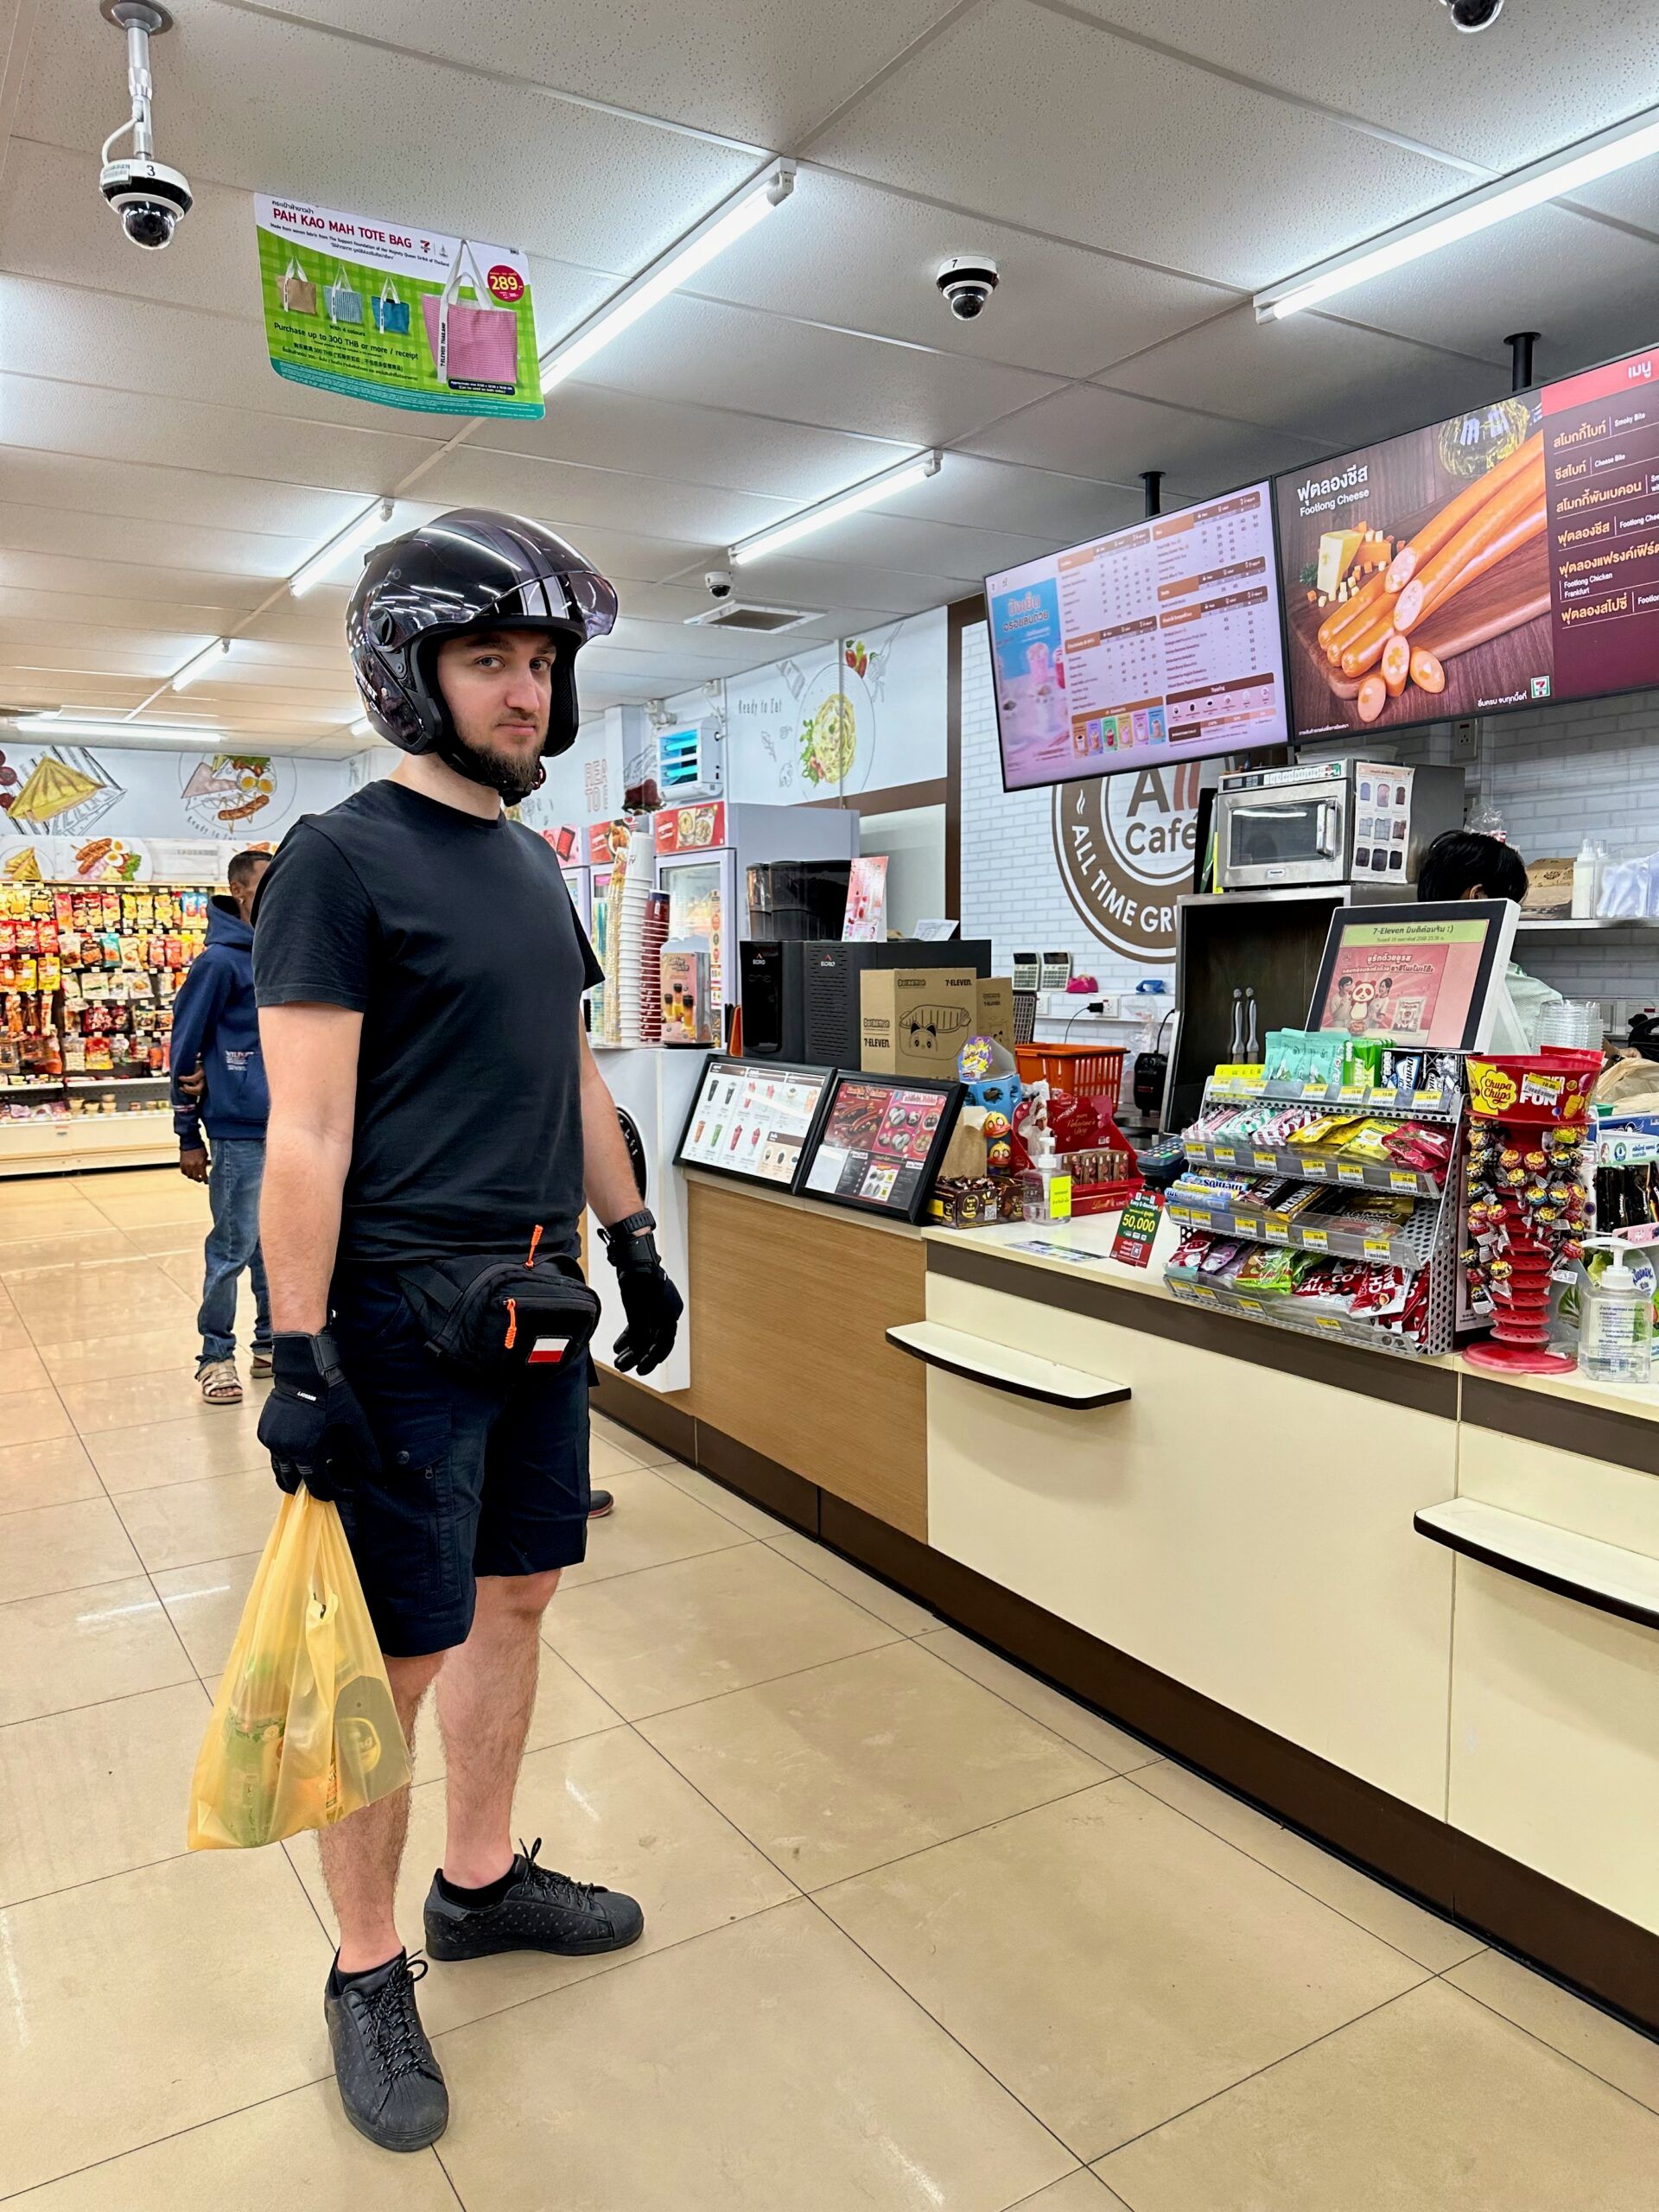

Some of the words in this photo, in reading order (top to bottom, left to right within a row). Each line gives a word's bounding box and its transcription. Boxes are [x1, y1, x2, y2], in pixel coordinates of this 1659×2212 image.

[146, 164, 156, 176] 3
[273, 207, 297, 224] PAH
[301, 214, 325, 229] KAO
[329, 220, 354, 235] MAH
[359, 226, 385, 243] TOTE
[390, 234, 412, 249] BAG
[338, 237, 353, 245] Support
[353, 241, 375, 250] Foundation
[389, 248, 404, 257] Majesty
[434, 259, 449, 268] Thailand
[952, 258, 958, 268] 7
[274, 322, 306, 337] Purchase
[308, 332, 317, 340] up
[319, 333, 327, 341] to
[328, 334, 343, 345] 300
[345, 338, 359, 348] THB
[370, 345, 388, 353] more
[395, 349, 419, 360] receipt
[347, 328, 365, 337] colours
[1628, 360, 1652, 378] เมนู
[1614, 416, 1633, 428] Smoky
[1634, 411, 1645, 422] Bite
[1554, 420, 1606, 448] สโมกกี้ไบท์
[1554, 459, 1586, 480] ชีสไบท์
[1594, 456, 1614, 467] Cheese
[1615, 454, 1625, 462] Bite
[1297, 464, 1369, 506] ฟุตลองชีส
[1300, 499, 1336, 517] Footlong
[1337, 489, 1370, 505] Cheese
[1556, 480, 1643, 513] สโมกกี้พันเบคอน
[1619, 517, 1644, 529] Footlong
[1557, 521, 1610, 548] ฟุตลองชีส
[1564, 577, 1588, 589] Footlong
[1589, 572, 1613, 584] Chicken
[1564, 587, 1590, 599] Frankfurt
[1561, 593, 1628, 625] ฟุตลองสไปซี่
[739, 699, 757, 716] Ready
[760, 700, 767, 714] to
[771, 698, 782, 714] Eat
[1127, 763, 1201, 817] All
[1126, 812, 1198, 855] Café
[1071, 825, 1096, 875] ALL
[1090, 869, 1138, 926] TIME
[1140, 905, 1176, 932] GR
[1372, 926, 1404, 935] 7-Eleven
[1484, 1078, 1512, 1090] Chupa
[1484, 1088, 1511, 1103] Chups
[1519, 1091, 1557, 1106] FUN
[1202, 1178, 1243, 1191] mentos
[1122, 1214, 1155, 1232] 50,000
